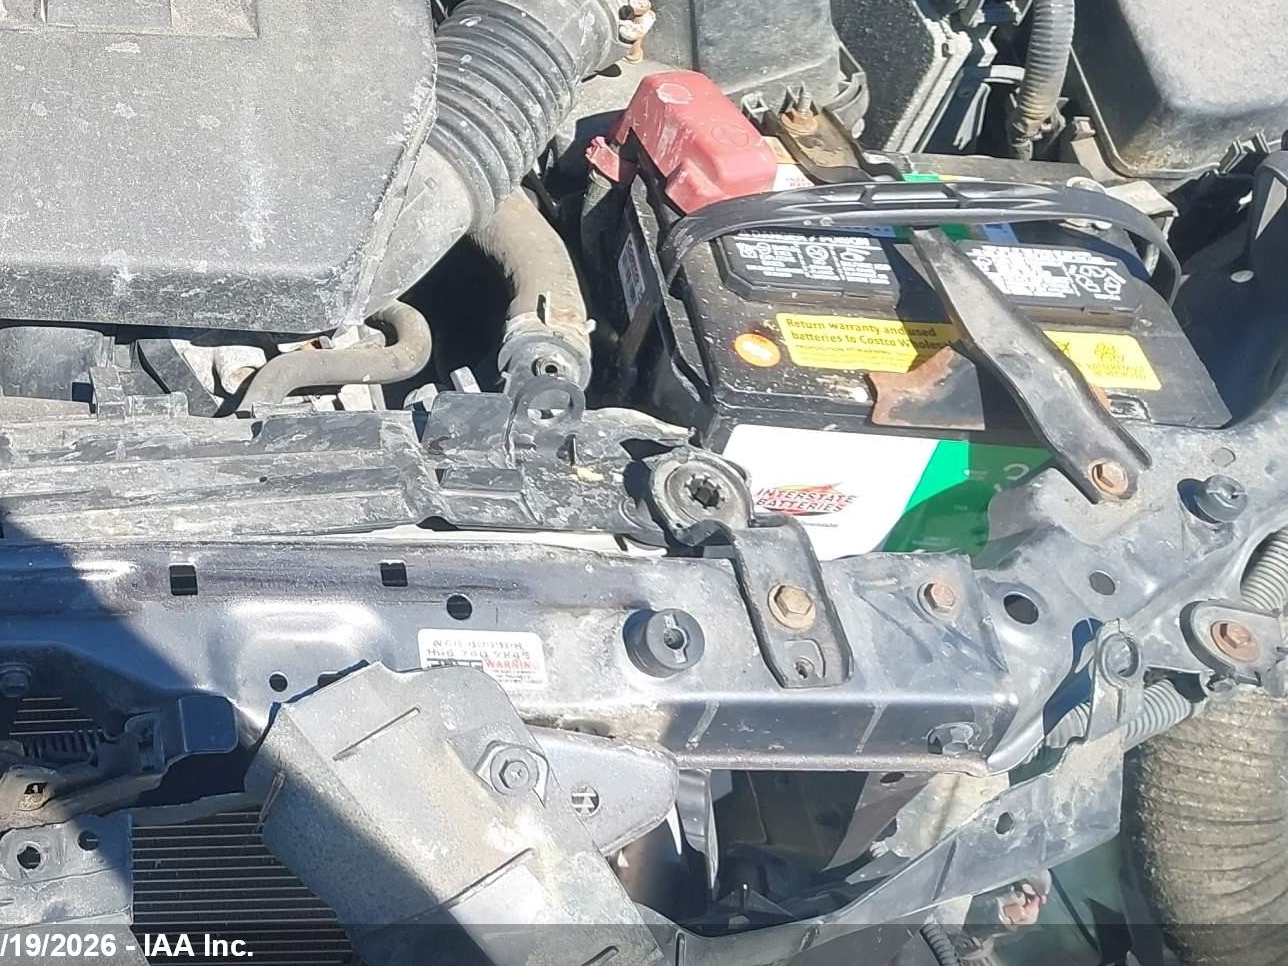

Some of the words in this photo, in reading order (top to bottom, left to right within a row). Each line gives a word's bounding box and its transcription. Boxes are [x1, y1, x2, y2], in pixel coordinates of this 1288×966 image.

[786, 318, 825, 330] Return
[828, 320, 880, 334] warranty
[883, 325, 905, 335] and
[905, 326, 937, 338] used
[792, 331, 843, 344] batteries
[845, 334, 857, 344] to
[860, 335, 897, 348] Costco
[757, 488, 857, 504] INTERSTATE
[755, 498, 843, 513] BATTERIES
[485, 658, 540, 671] WARNING
